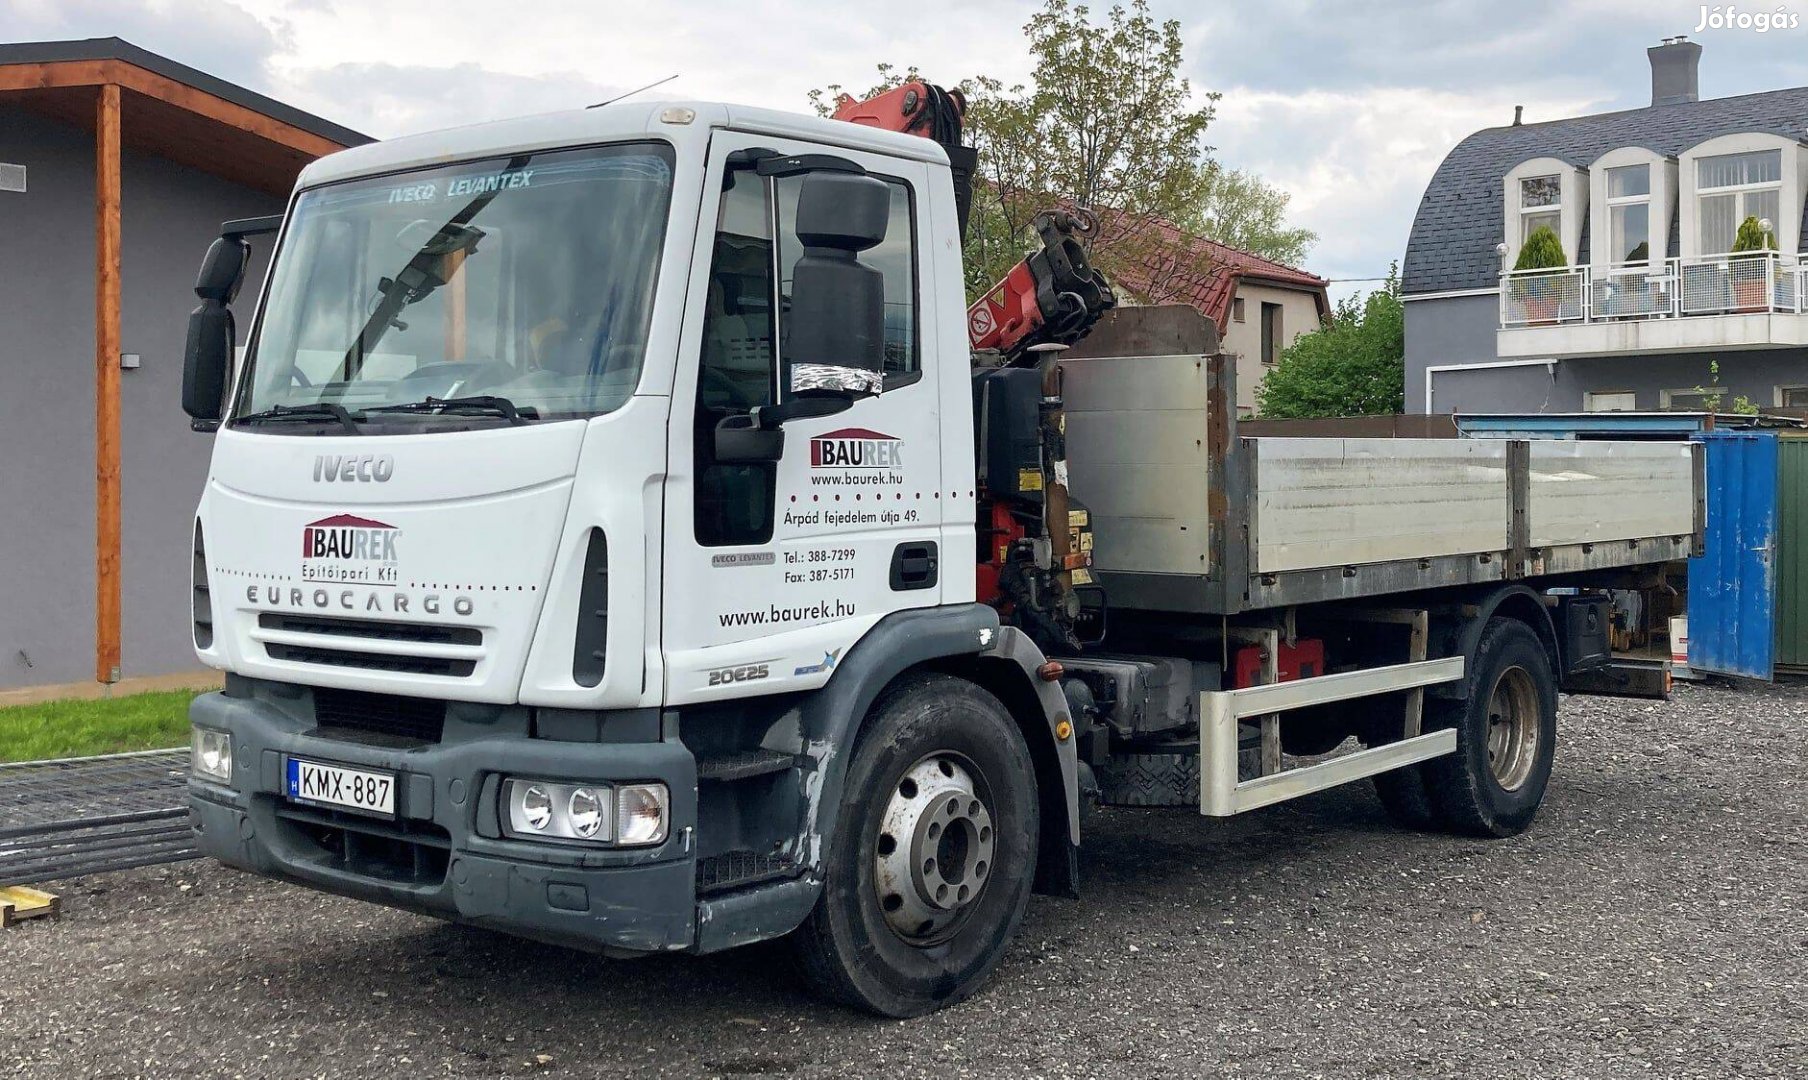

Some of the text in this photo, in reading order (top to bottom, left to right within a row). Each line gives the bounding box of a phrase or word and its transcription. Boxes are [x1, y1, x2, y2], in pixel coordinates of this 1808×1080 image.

[388, 170, 533, 204] IVECO LEVANTEX
[822, 440, 902, 466] BAUREK
[313, 454, 394, 482] IVECO
[811, 471, 903, 485] www.baurek.hu
[783, 508, 920, 527] Árpád fejedelem útja 49.
[314, 528, 397, 560] BAUREK
[783, 549, 856, 564] Tel.: 388-7299
[302, 561, 397, 580] Építőipari Kft
[784, 568, 854, 583] Fax: 387-5171
[246, 585, 474, 615] EUROCARGO
[719, 598, 855, 627] www.baurek.hu
[708, 664, 769, 687] 20E25
[291, 766, 390, 808] H KMX-887
